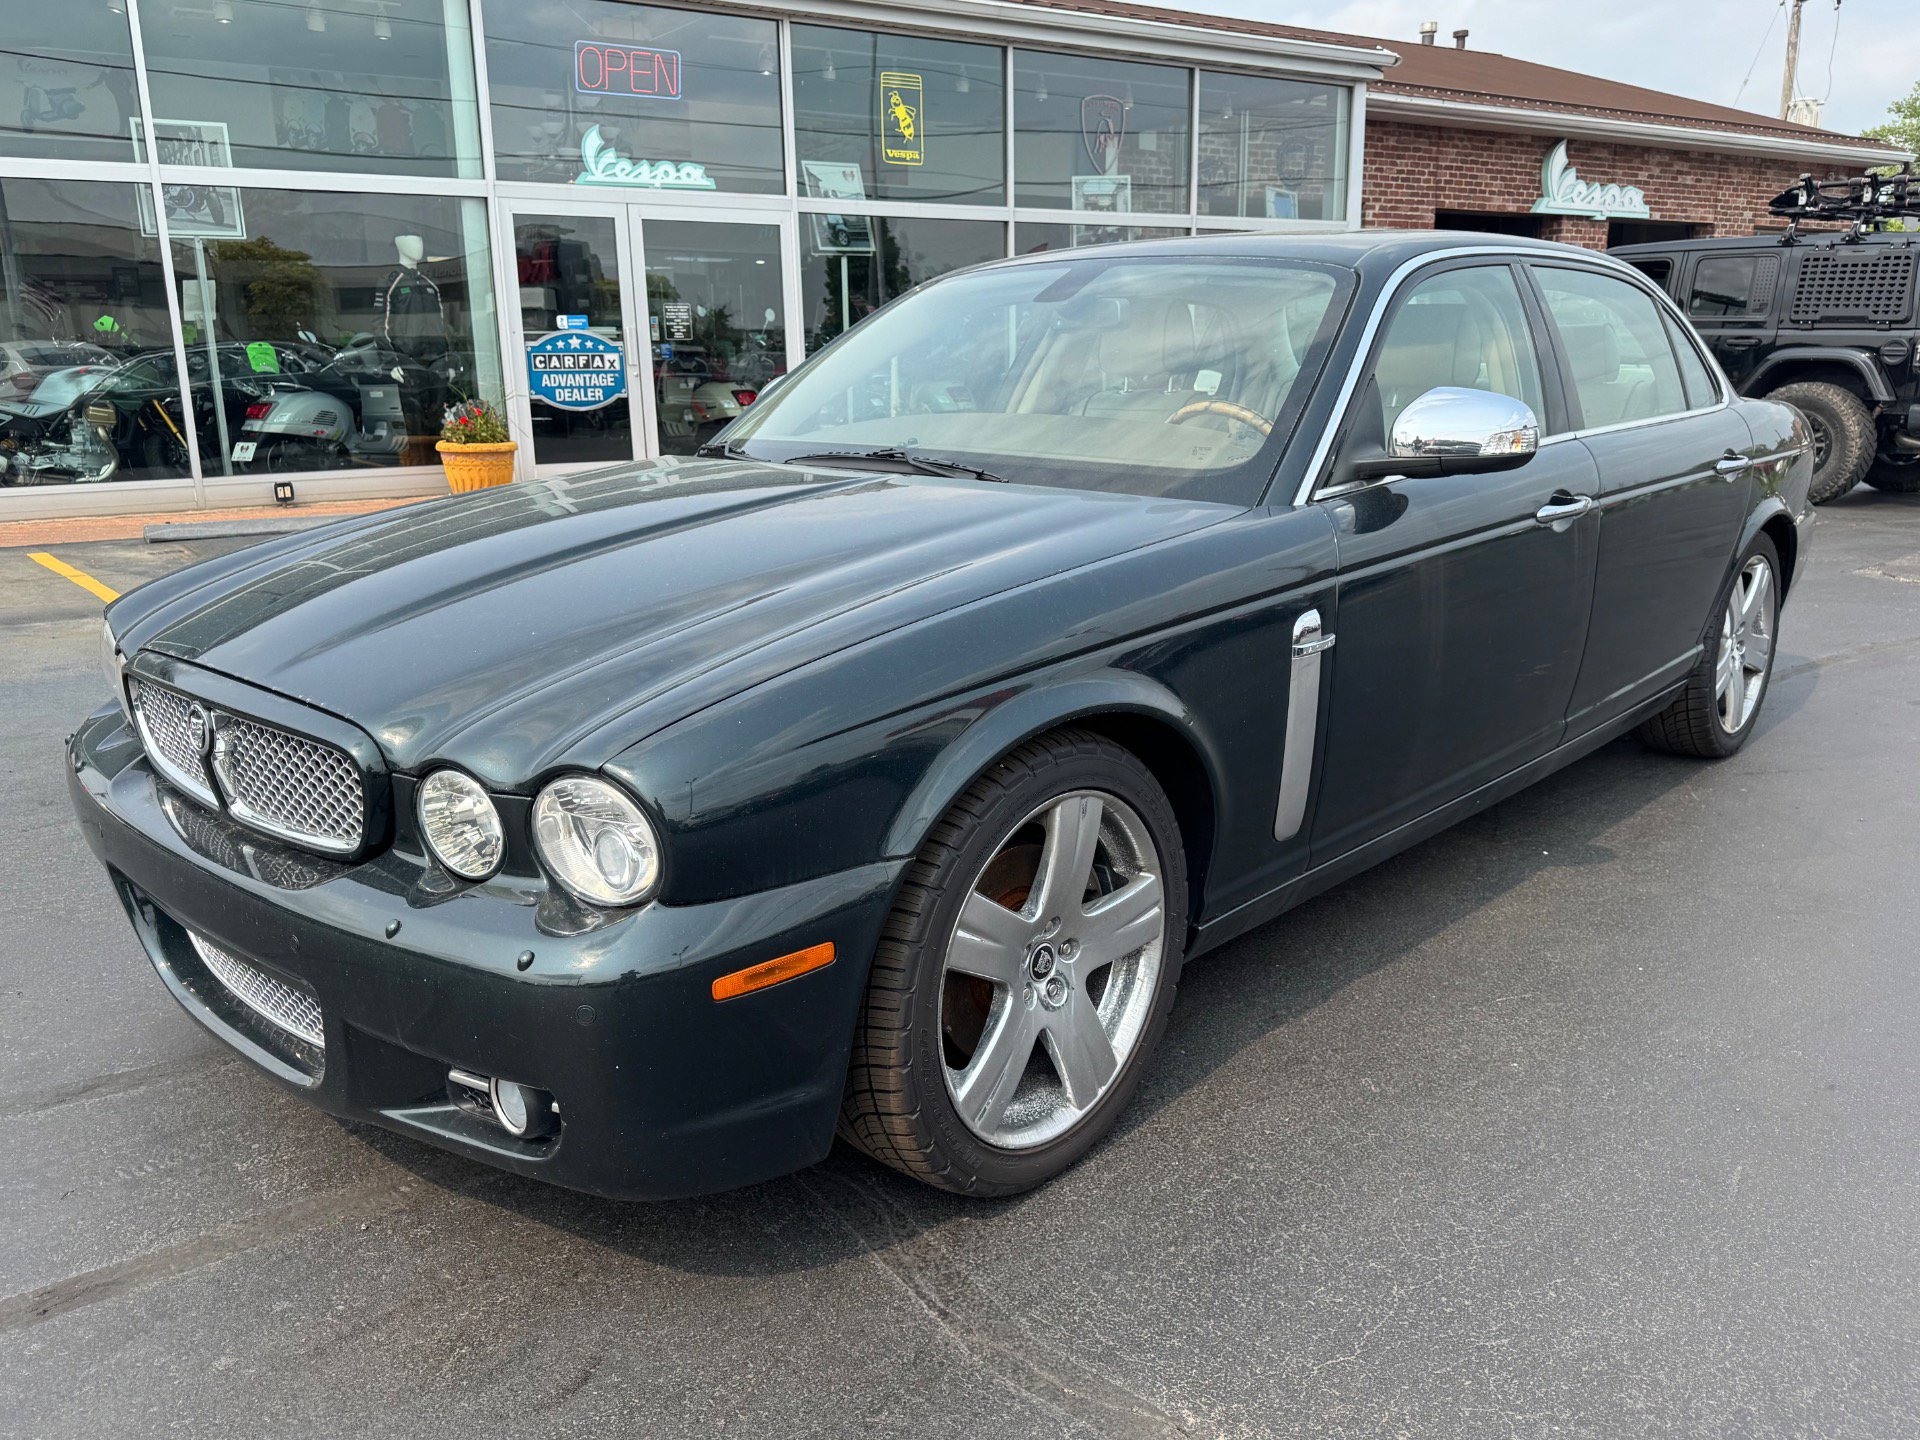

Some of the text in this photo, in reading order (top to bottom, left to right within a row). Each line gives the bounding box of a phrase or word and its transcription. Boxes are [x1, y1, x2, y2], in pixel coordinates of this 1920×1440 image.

[579, 46, 677, 95] OPEN
[577, 124, 715, 188] Vespa
[886, 149, 920, 160] Vespa
[1535, 138, 1650, 219] Vespa
[534, 355, 618, 369] CARFAX
[555, 388, 604, 401] DEALER
